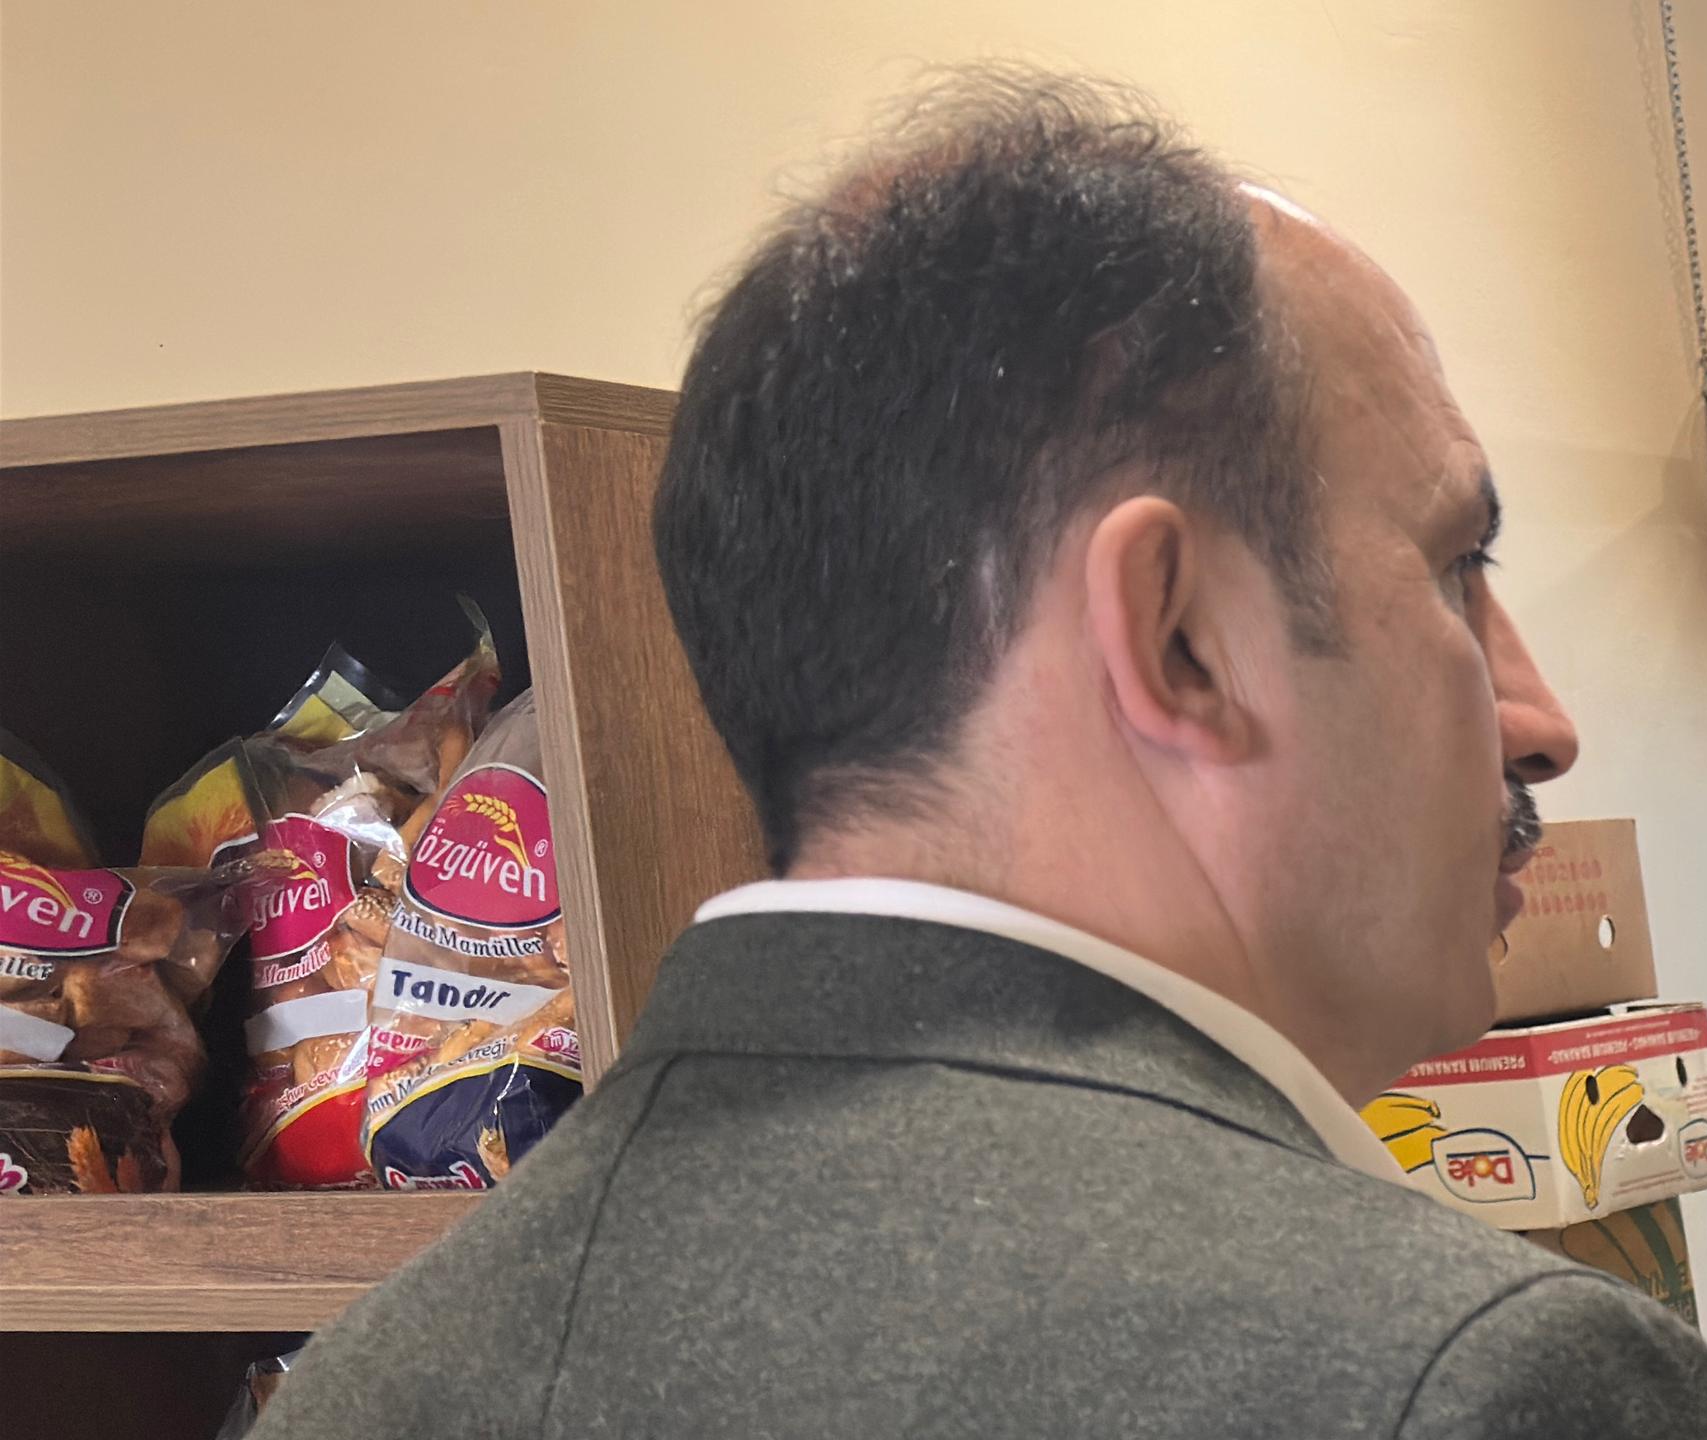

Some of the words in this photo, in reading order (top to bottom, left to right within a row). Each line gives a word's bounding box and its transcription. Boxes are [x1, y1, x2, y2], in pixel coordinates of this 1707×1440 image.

[416, 827, 547, 902] özgüven
[0, 885, 94, 938] ven
[439, 925, 544, 957] Mamüller
[1447, 1157, 1515, 1188] Dole
